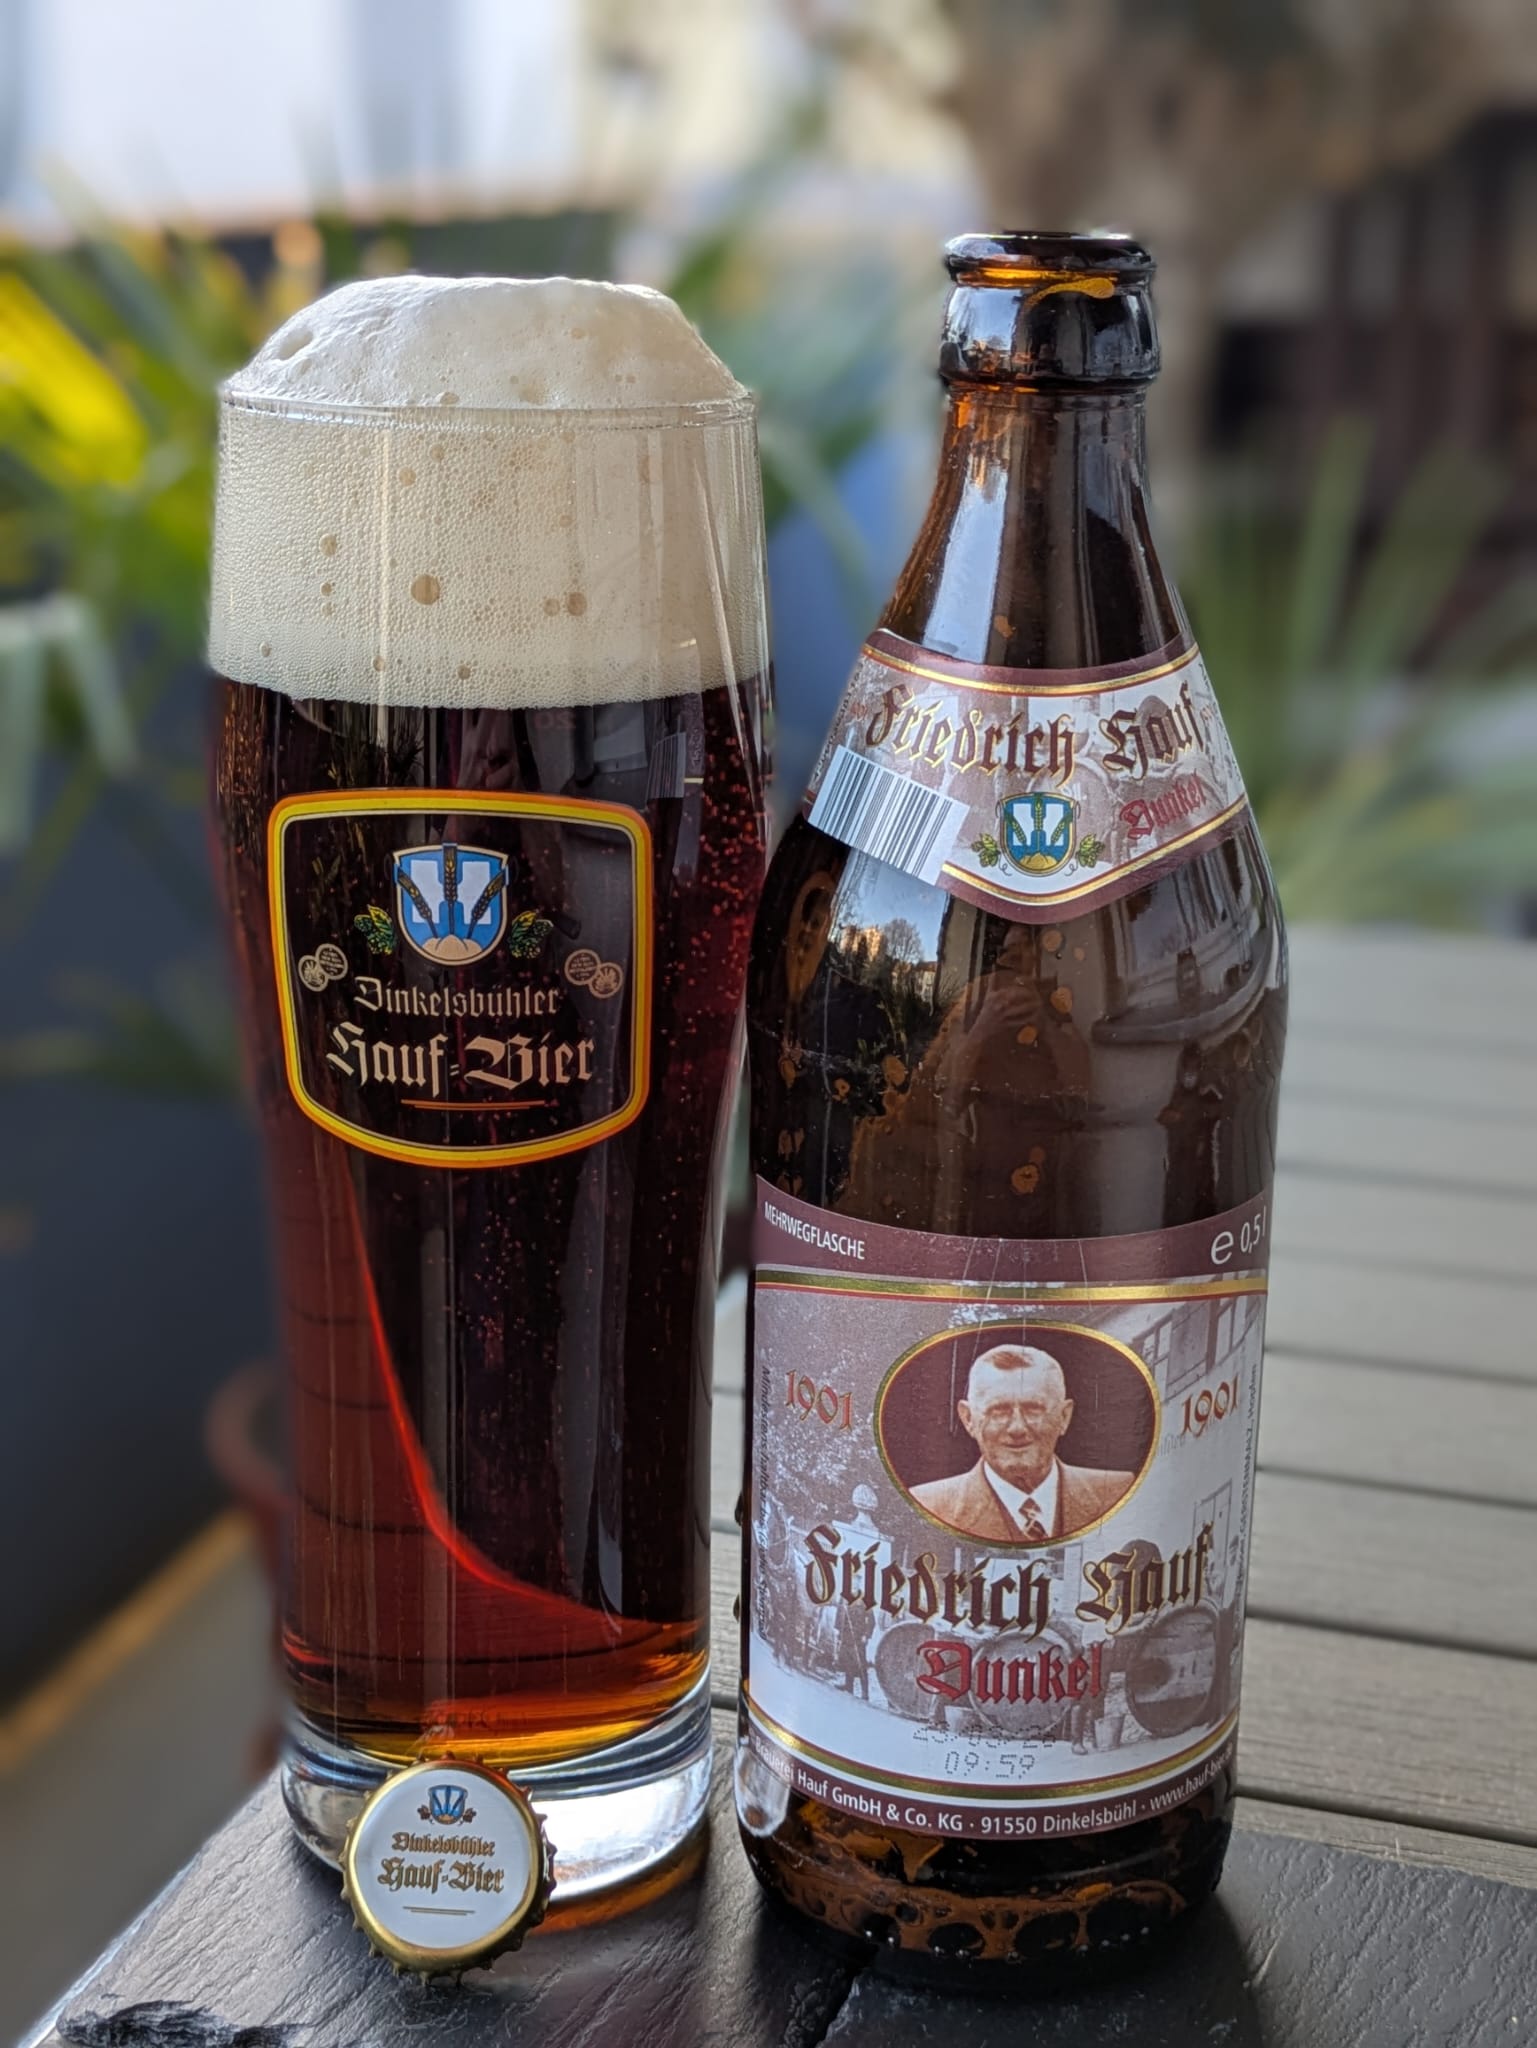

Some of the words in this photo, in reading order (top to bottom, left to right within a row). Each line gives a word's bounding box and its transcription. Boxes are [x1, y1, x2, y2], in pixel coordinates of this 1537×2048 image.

[866, 684, 1076, 788] Friedrich
[1100, 681, 1205, 781] Hauf
[1119, 768, 1207, 840] Dunkel
[353, 976, 561, 1020] Dinkelsbühler
[764, 1200, 866, 1261] MEHRWEGFLASCHE
[785, 1369, 853, 1430] 1901
[1181, 1372, 1239, 1439] 1901
[804, 1523, 1051, 1643] Friedrich
[1075, 1520, 1215, 1636] Hauf
[916, 1640, 1105, 1705] Dunkel
[755, 1736, 795, 1781] Brauerei
[797, 1768, 828, 1797] Hauf
[832, 1787, 881, 1817] GmbH
[886, 1803, 900, 1821] &
[904, 1807, 932, 1828] Co.
[938, 1812, 963, 1832] KG
[981, 1816, 1037, 1834] 91550
[1043, 1799, 1137, 1834] Dinkelsbühl
[944, 1751, 1035, 1780] 09:59
